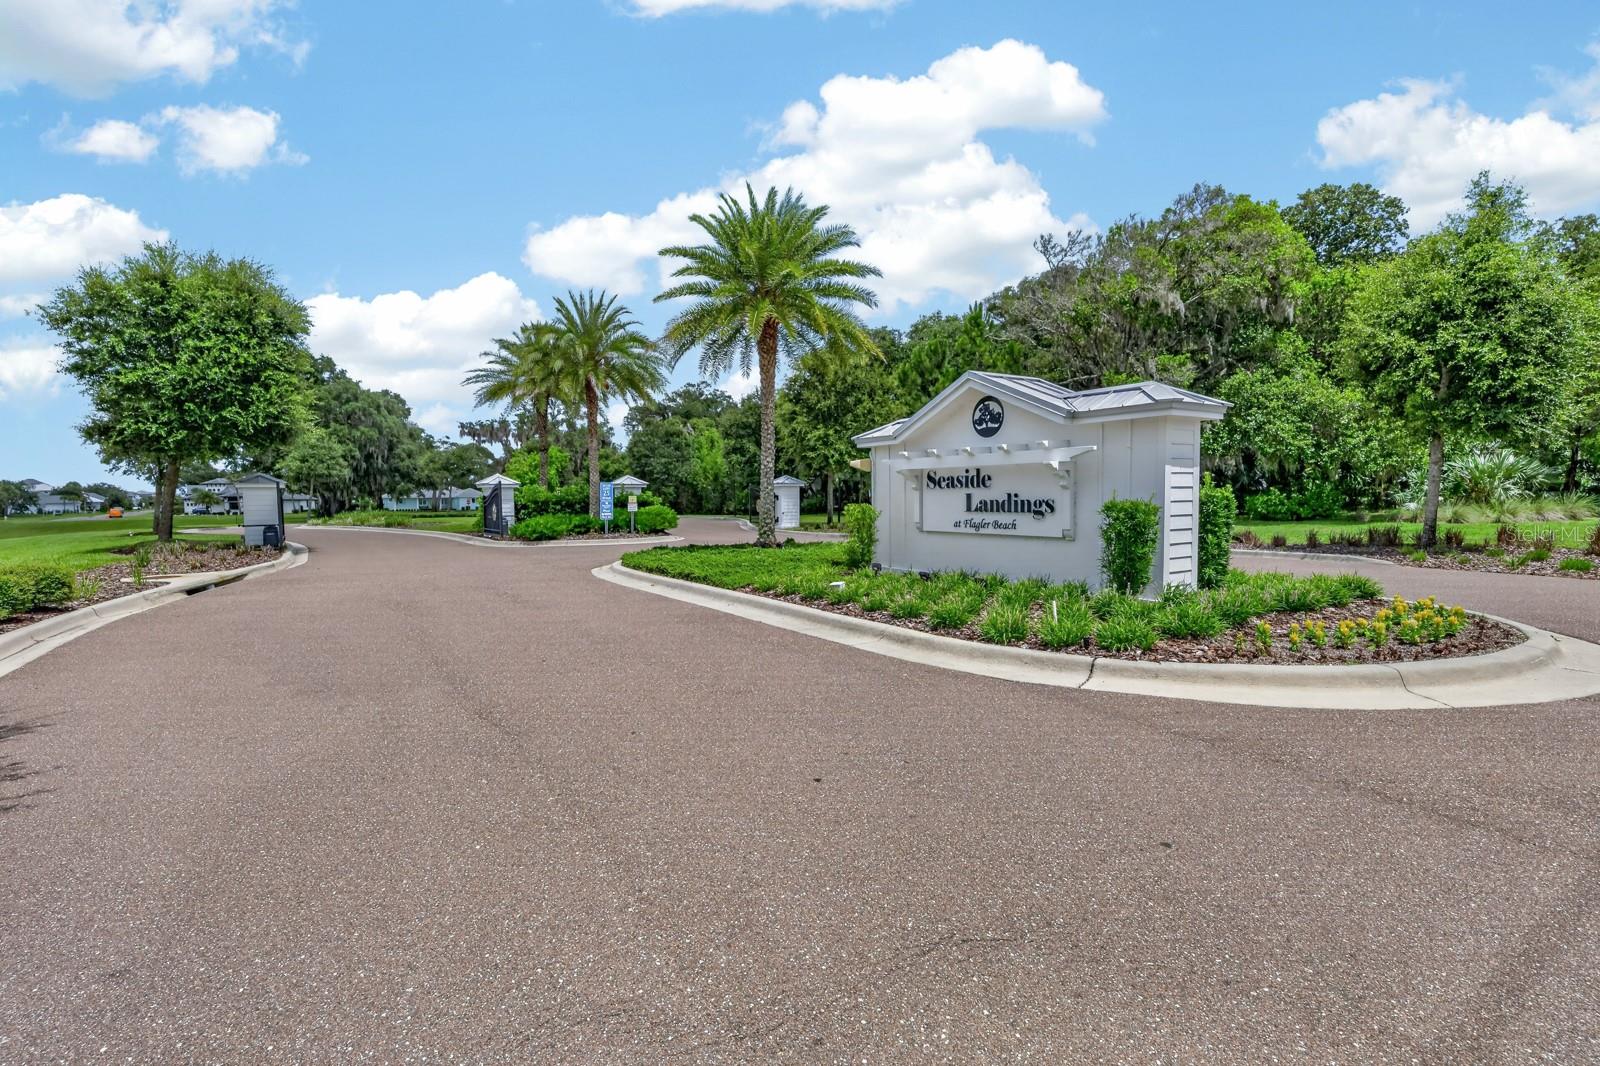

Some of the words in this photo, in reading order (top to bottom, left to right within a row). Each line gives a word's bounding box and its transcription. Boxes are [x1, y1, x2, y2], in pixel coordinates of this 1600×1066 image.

[926, 468, 992, 489] Seaside
[964, 493, 1055, 520] Landings
[953, 520, 961, 528] at
[963, 519, 991, 532] Flagler
[991, 519, 1017, 530] Beach
